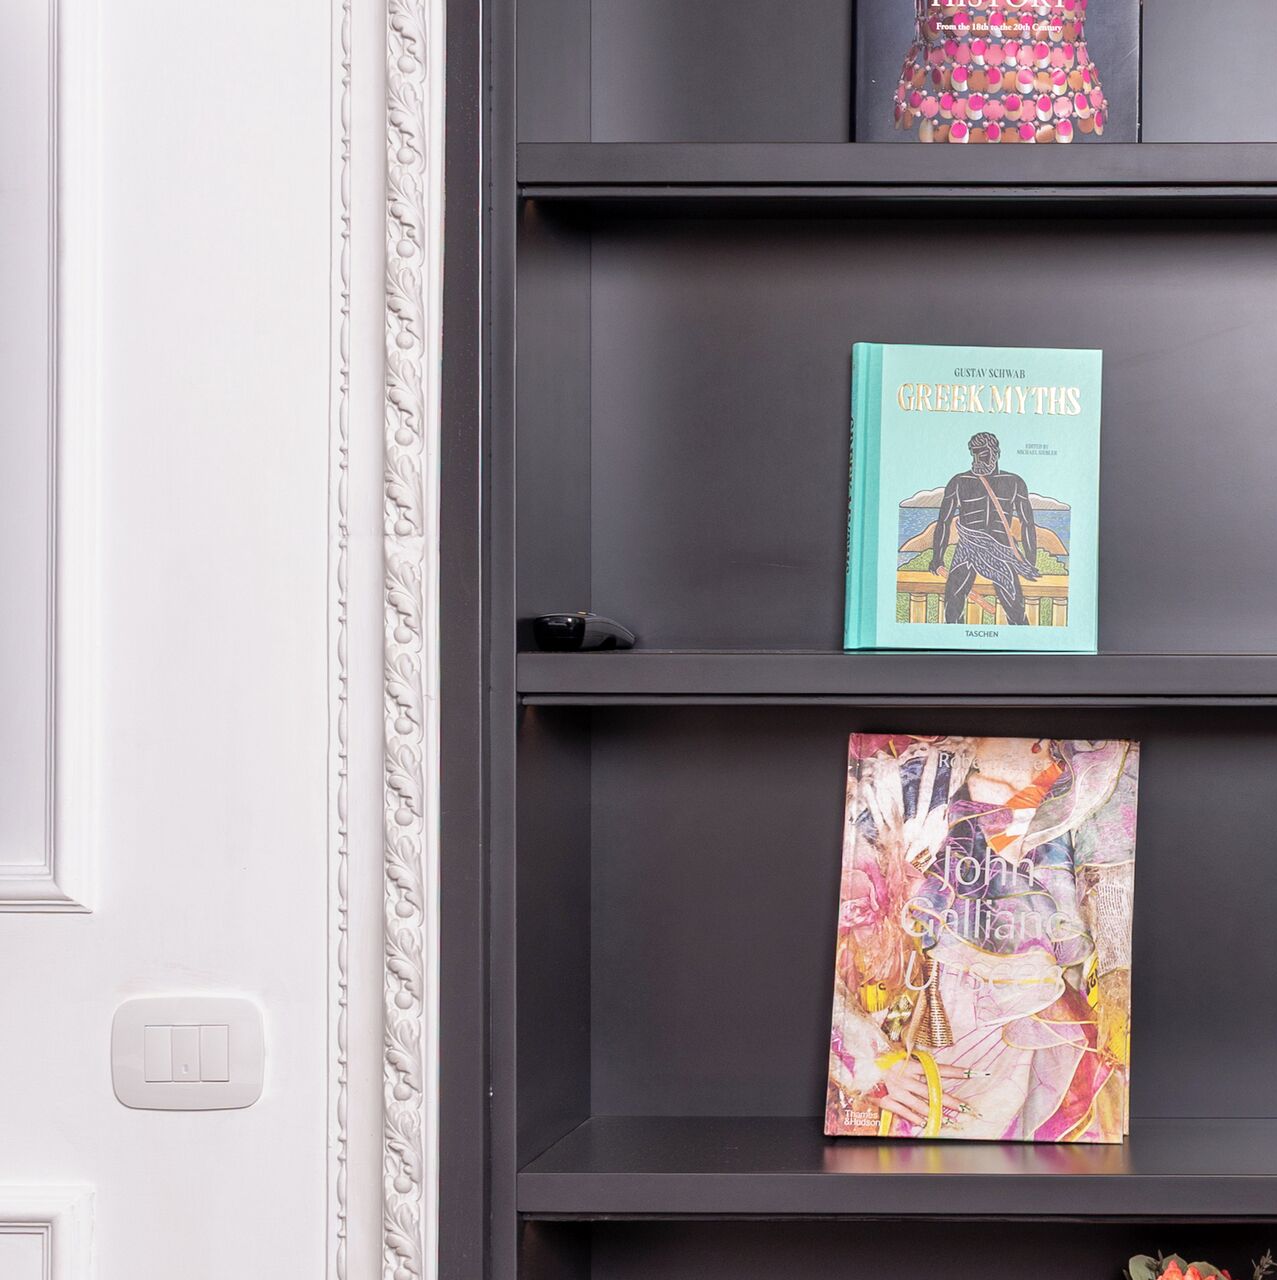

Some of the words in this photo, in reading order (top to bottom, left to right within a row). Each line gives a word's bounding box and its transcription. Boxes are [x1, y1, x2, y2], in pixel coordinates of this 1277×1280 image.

[936, 22, 957, 31] From
[958, 22, 970, 31] the
[972, 22, 989, 31] 18th
[990, 23, 1000, 31] to
[1000, 22, 1012, 31] the
[1013, 22, 1030, 31] 20th
[1032, 22, 1063, 33] Century
[953, 367, 987, 378] GUSTAV
[988, 368, 1026, 379] SCHWAB
[896, 383, 985, 413] GREEK
[988, 384, 1082, 416] MYTHS
[965, 630, 999, 638] TASCHEN
[938, 846, 1034, 891] John
[901, 897, 1071, 942] Galliano
